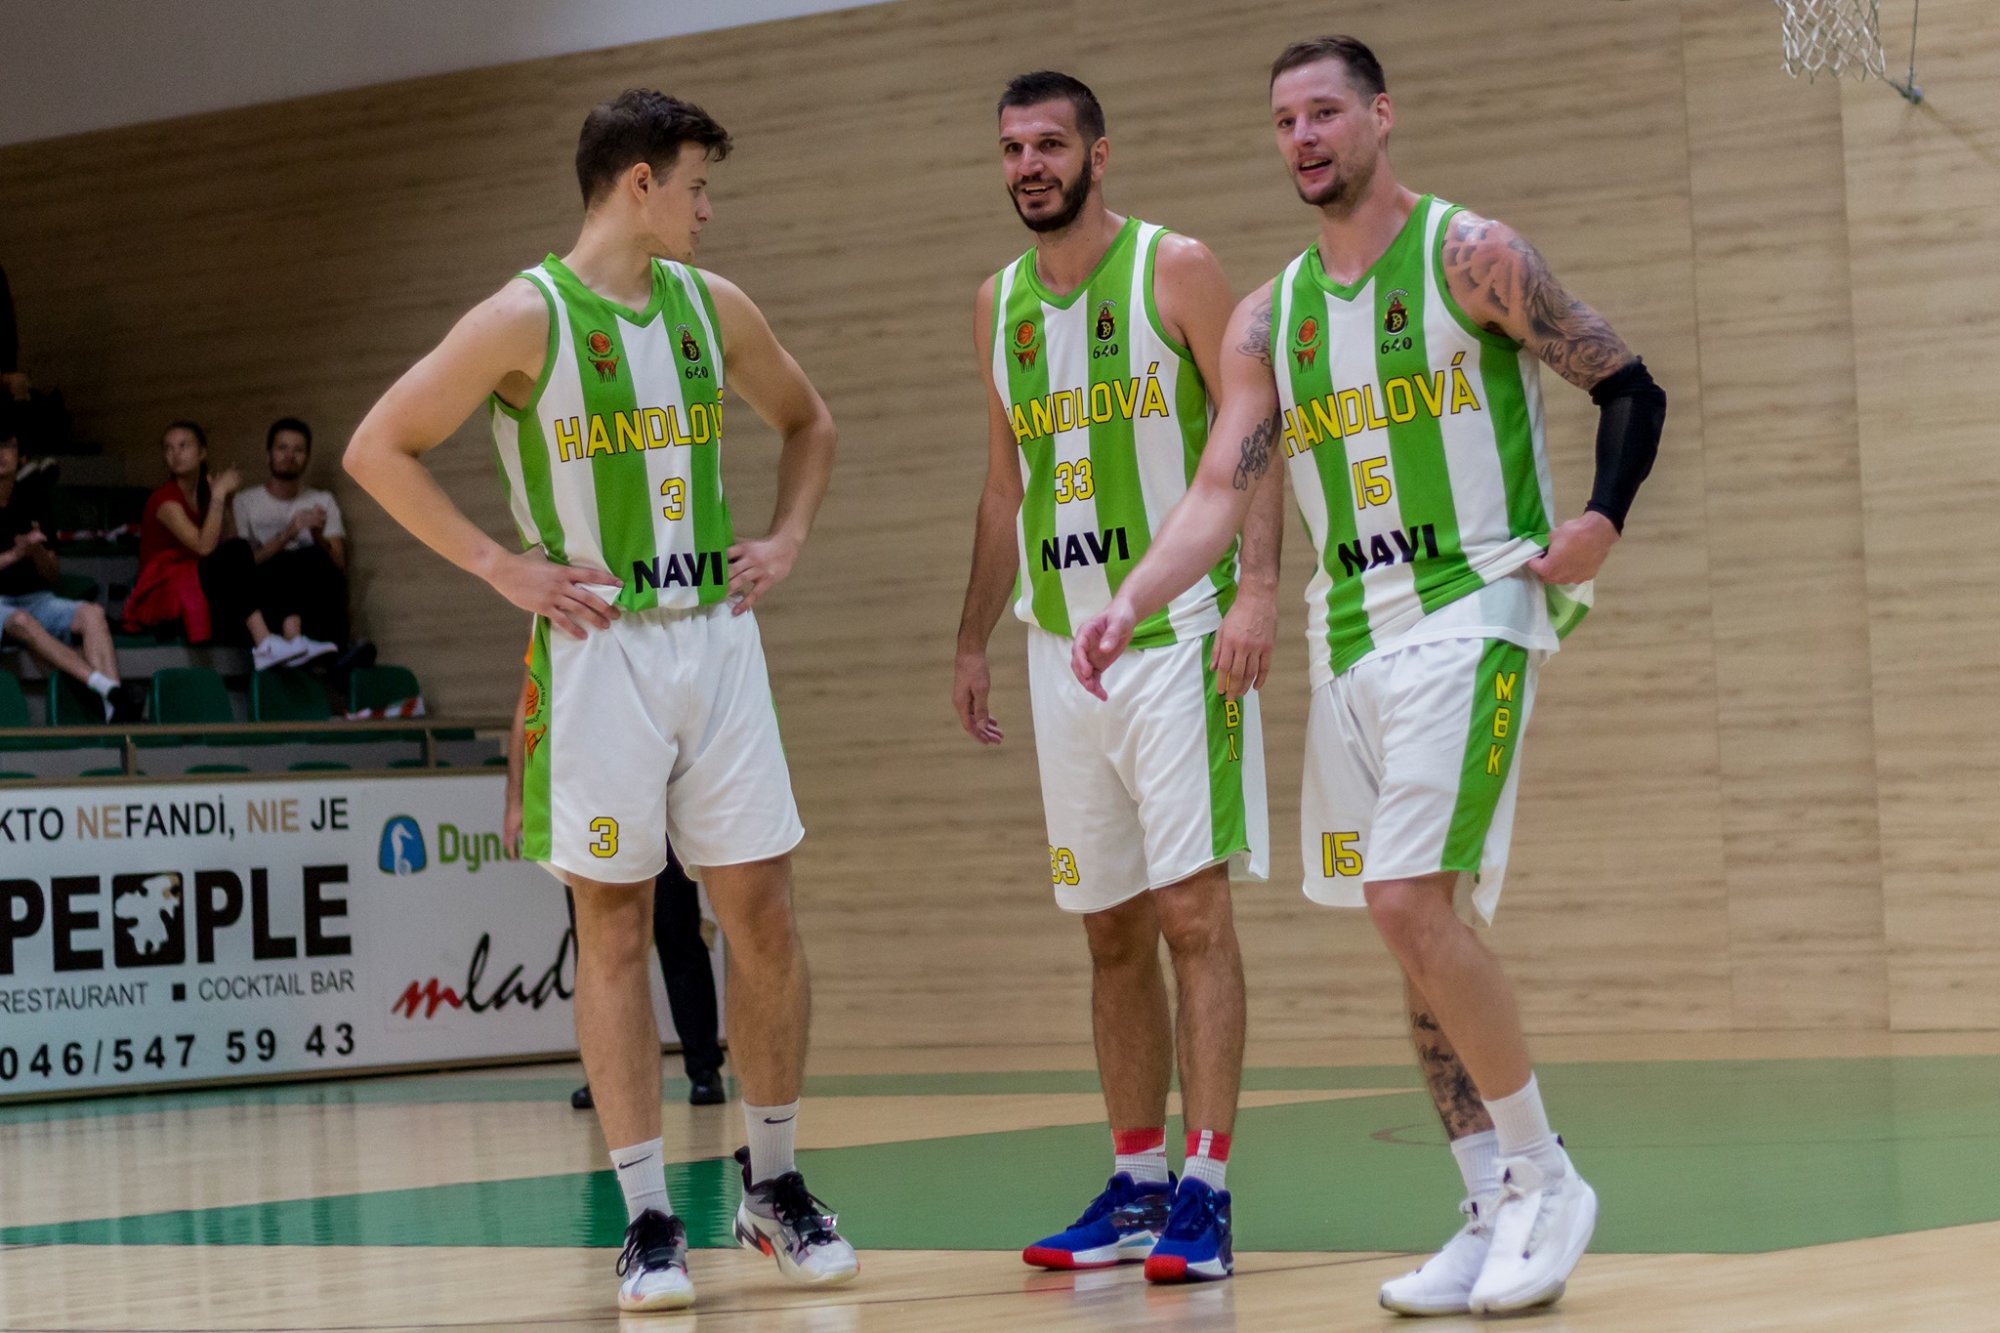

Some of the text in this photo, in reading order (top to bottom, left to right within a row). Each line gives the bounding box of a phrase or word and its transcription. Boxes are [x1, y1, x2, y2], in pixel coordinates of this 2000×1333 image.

[1092, 343, 1119, 359] 640
[1381, 336, 1413, 355] 640
[554, 387, 724, 462] HANDLOV
[1006, 361, 1170, 446] ANDLOVÁ
[1284, 351, 1481, 458] HANDLOVÁ
[660, 476, 686, 521] 3
[1054, 457, 1096, 504] 33
[1352, 456, 1392, 510] 15
[632, 551, 724, 594] NAVI
[1041, 526, 1130, 572] NAVI
[1337, 523, 1439, 577] NAVI
[1485, 671, 1517, 776] MBK
[0, 806, 65, 843] KTO
[246, 799, 300, 834] NIE
[310, 797, 349, 832] JE
[589, 816, 619, 858] 3
[1321, 831, 1364, 878] 15
[0, 864, 352, 975] PEOPLE
[0, 969, 355, 1014] RESTAURANT COCKTAIL BAR
[0, 1022, 355, 1081] 046/547 59 43
